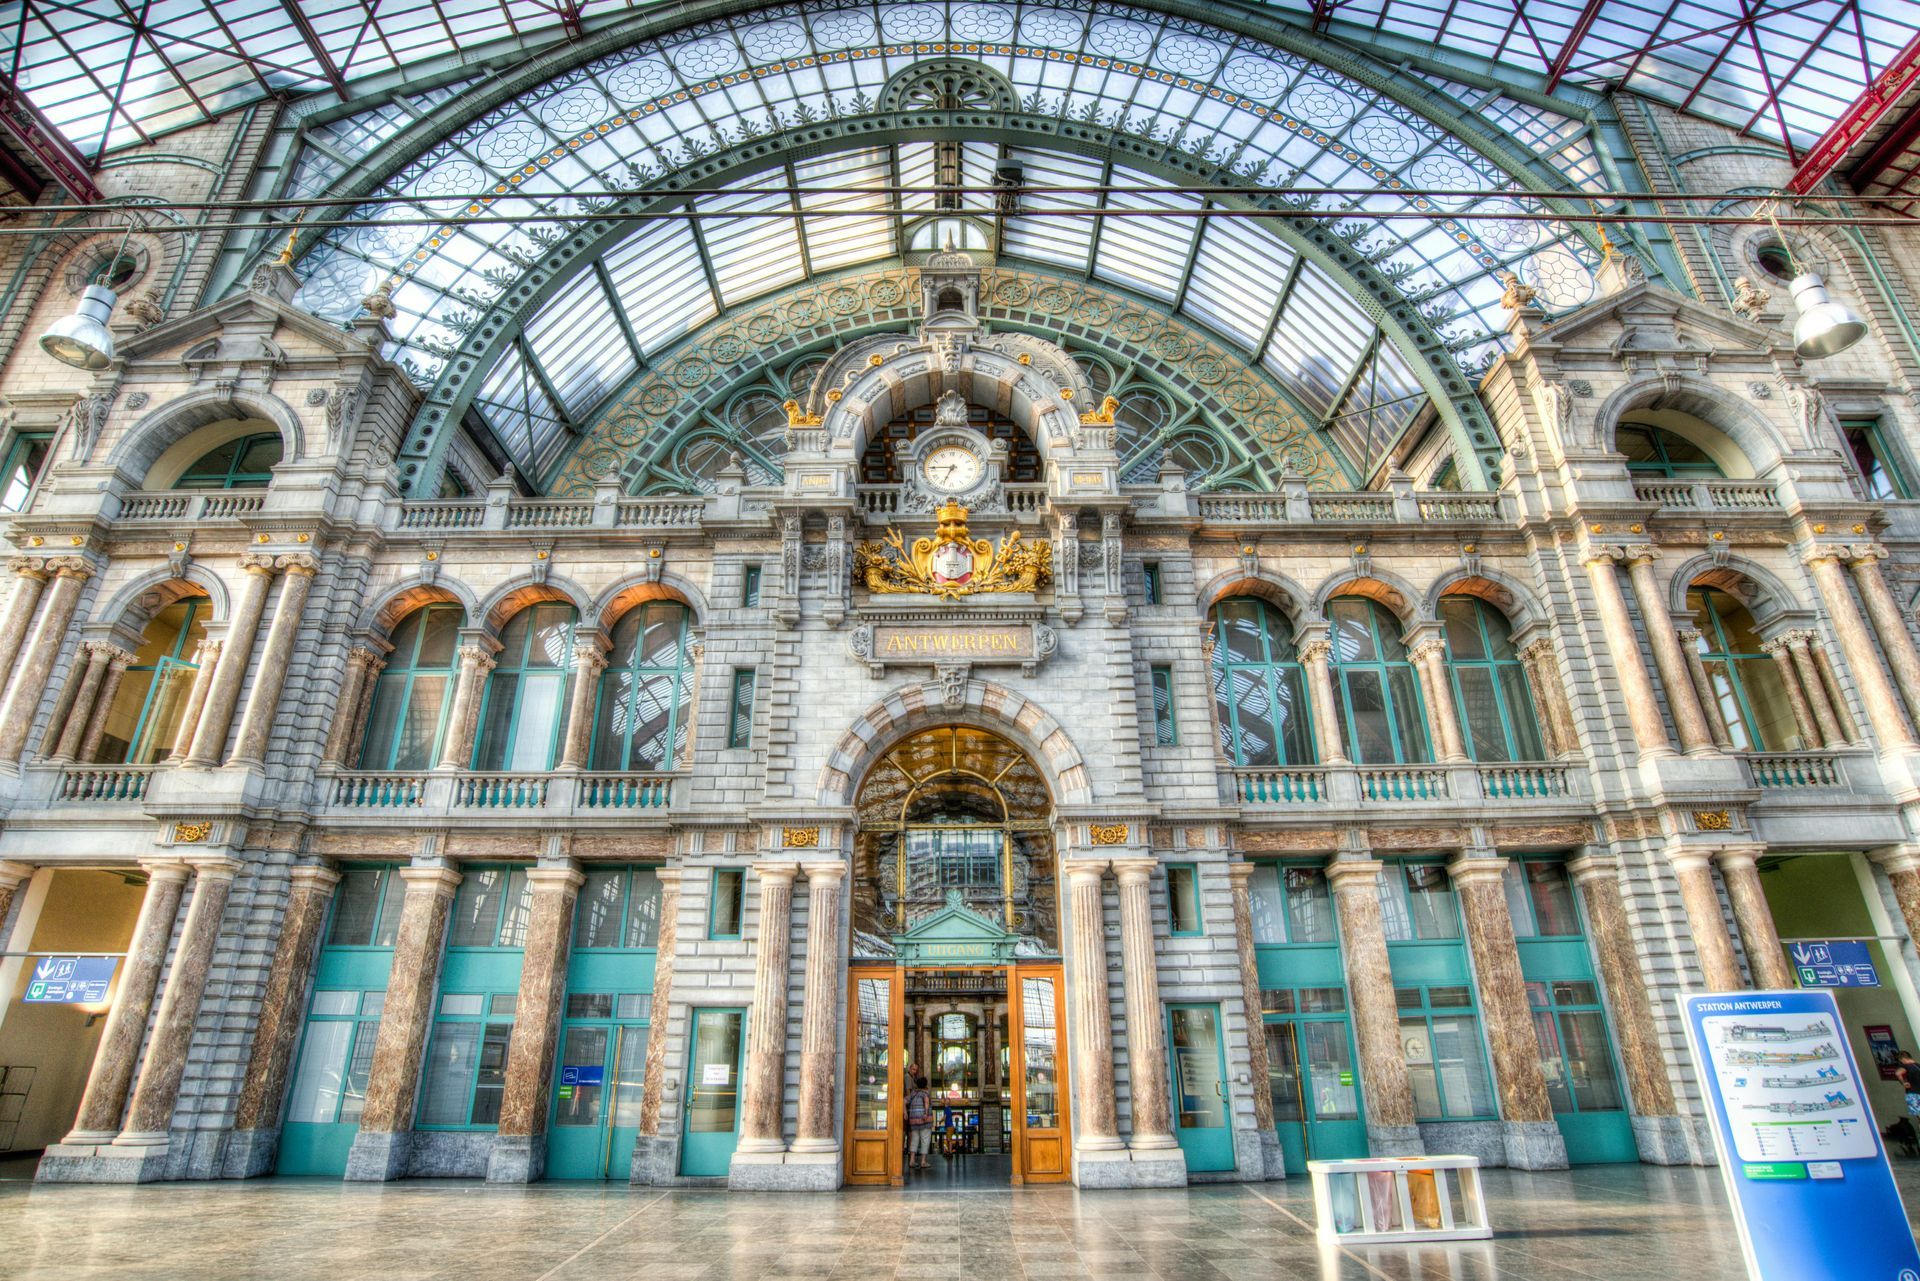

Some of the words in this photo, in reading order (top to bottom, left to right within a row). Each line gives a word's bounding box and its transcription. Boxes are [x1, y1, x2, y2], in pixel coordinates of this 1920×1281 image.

[887, 633, 1018, 651] ANTWERPEN
[927, 943, 985, 957] UITGANG
[1696, 1002, 1734, 1013] STATION
[1734, 1000, 1783, 1011] ANTWERPEN
